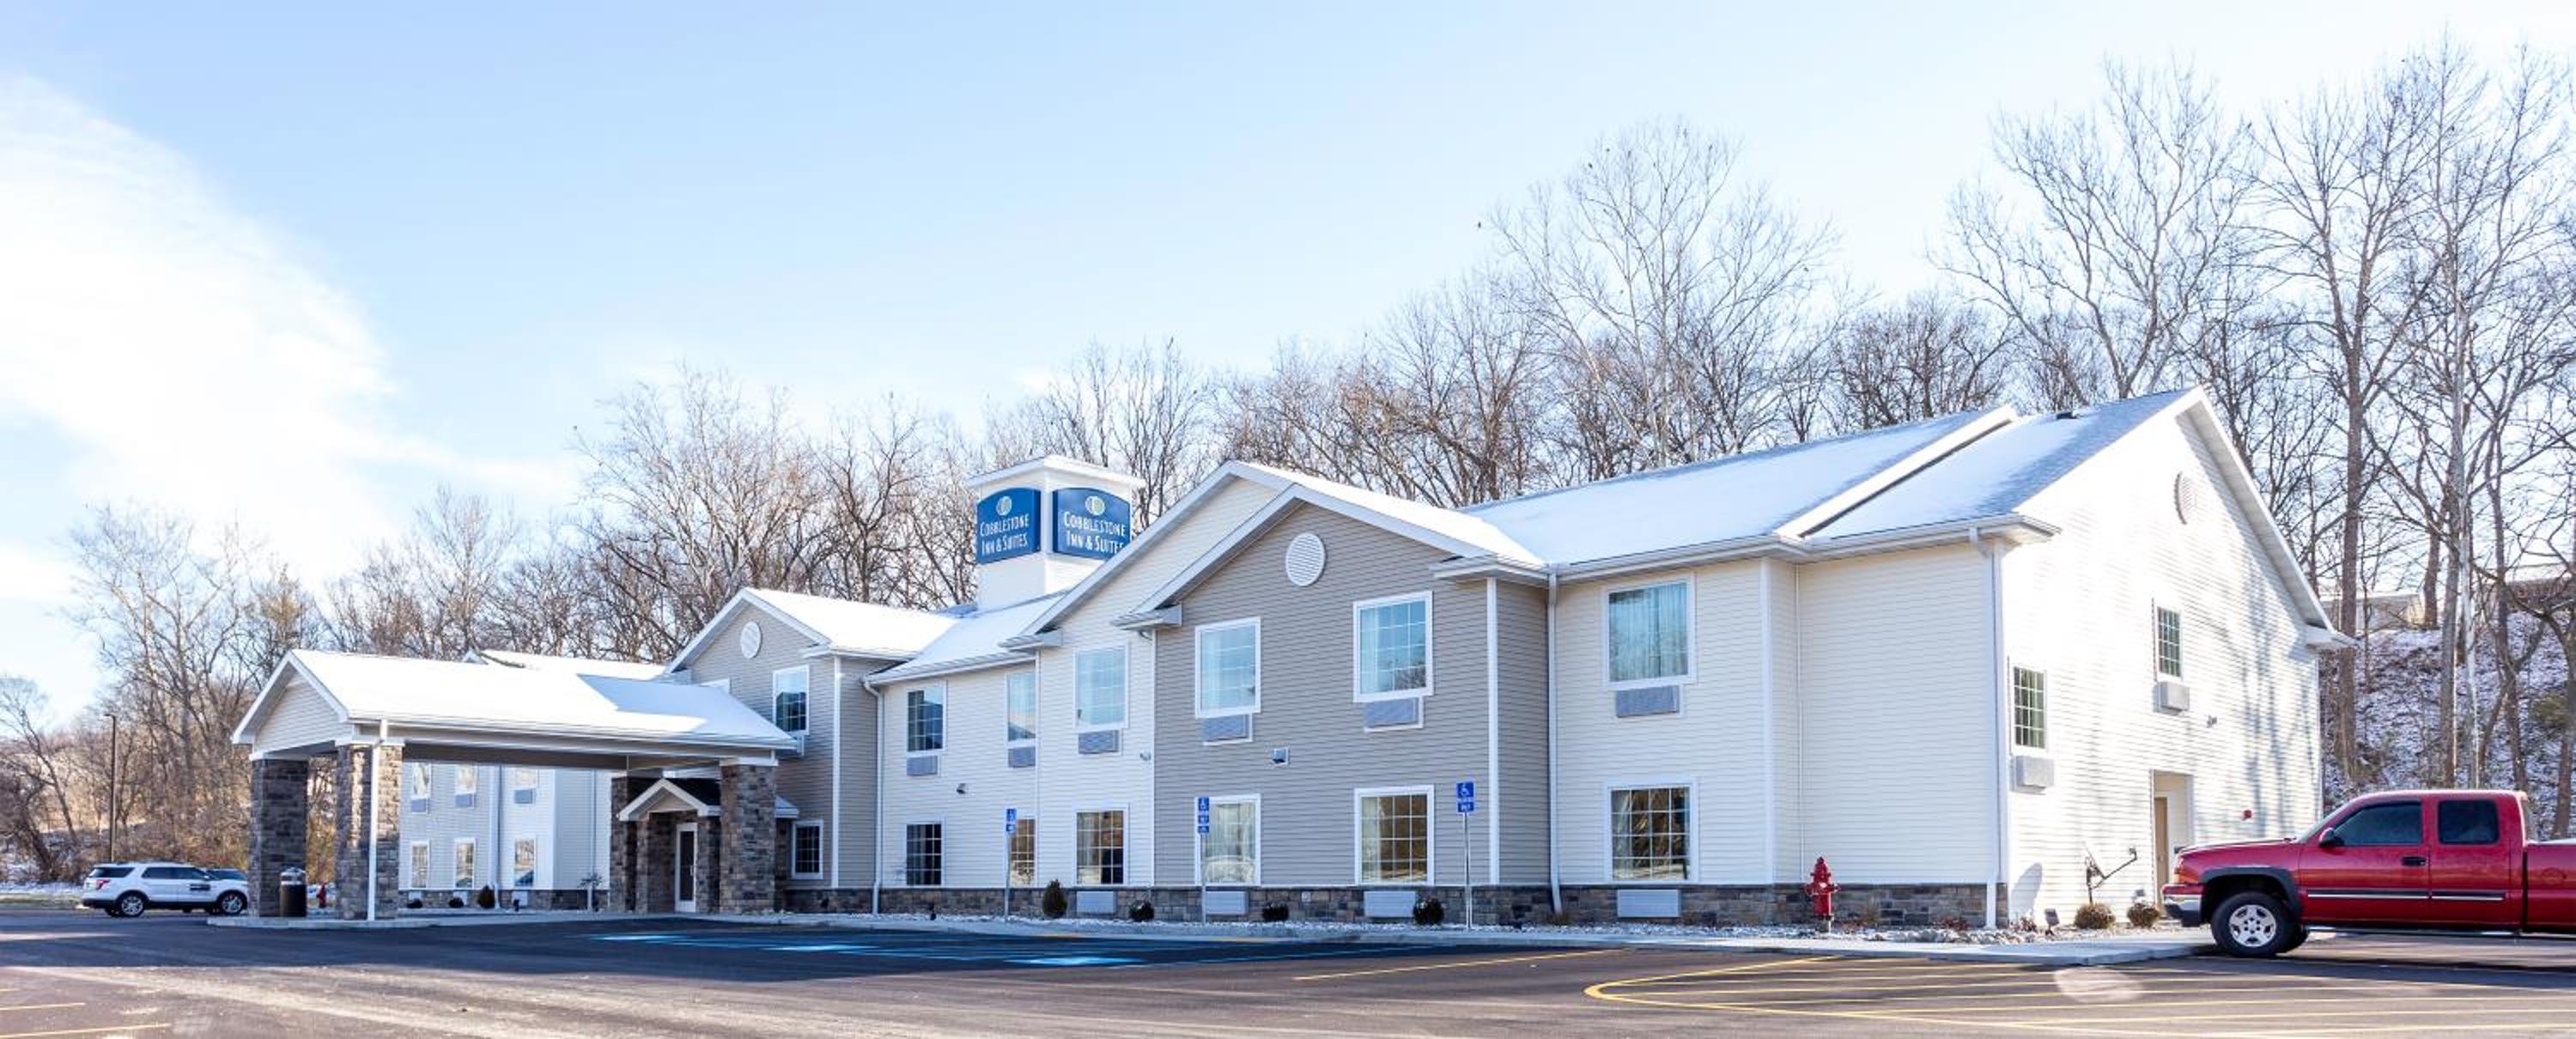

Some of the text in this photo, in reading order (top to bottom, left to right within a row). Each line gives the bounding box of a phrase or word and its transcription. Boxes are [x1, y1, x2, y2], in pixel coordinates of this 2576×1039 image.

[980, 513, 1030, 537] COBBLESTONE
[1064, 511, 1126, 537] COBBLESTONE
[981, 533, 1028, 556] INN & SUITES
[1066, 531, 1083, 548] INN
[1084, 534, 1093, 550] &
